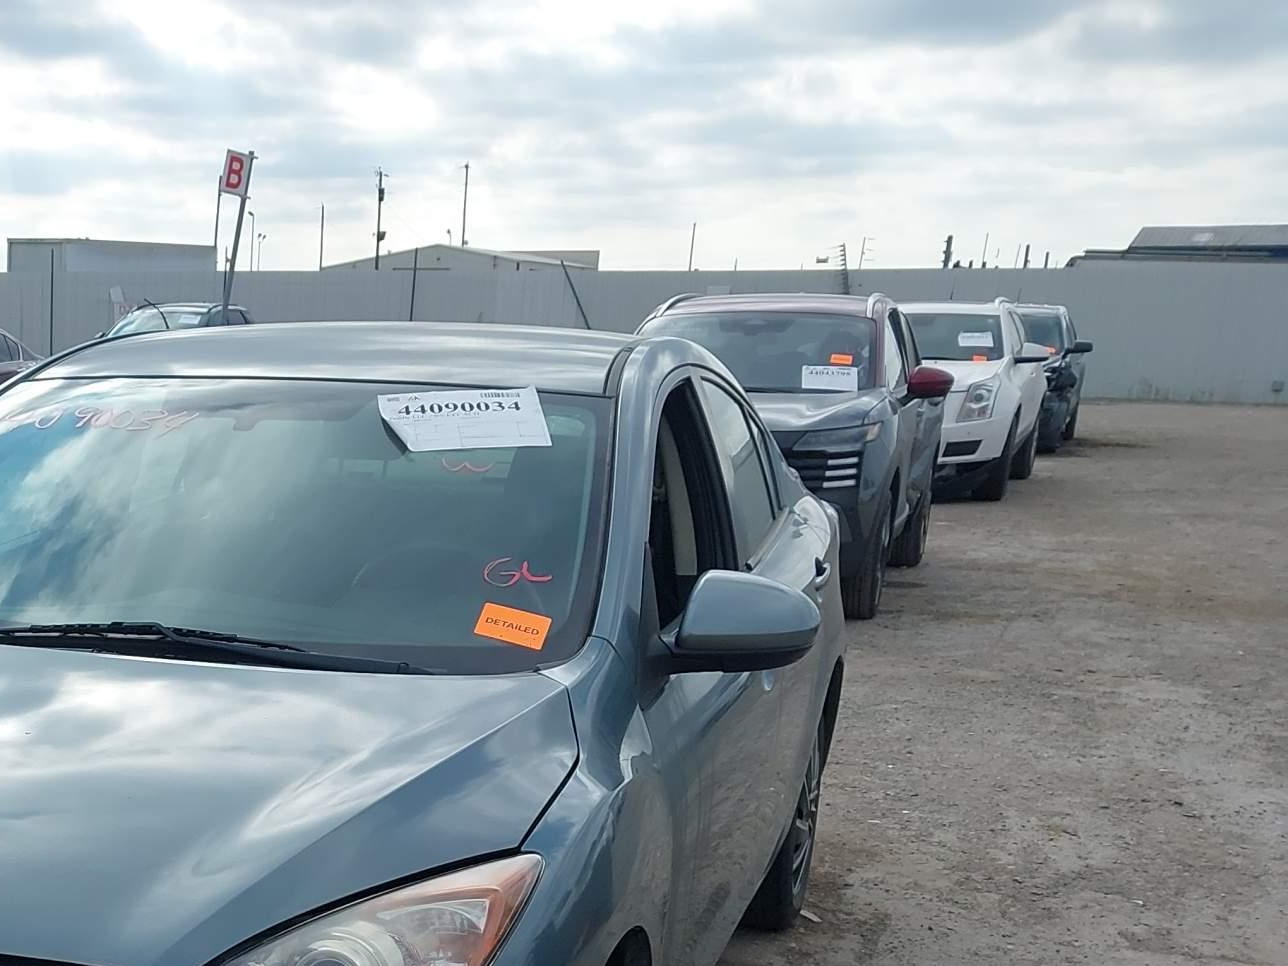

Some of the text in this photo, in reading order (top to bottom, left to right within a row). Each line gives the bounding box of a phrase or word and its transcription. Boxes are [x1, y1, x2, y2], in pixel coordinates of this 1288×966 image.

[226, 156, 244, 189] B
[397, 400, 521, 416] 44090034
[483, 556, 553, 587] GL
[484, 616, 540, 636] DETAILED
